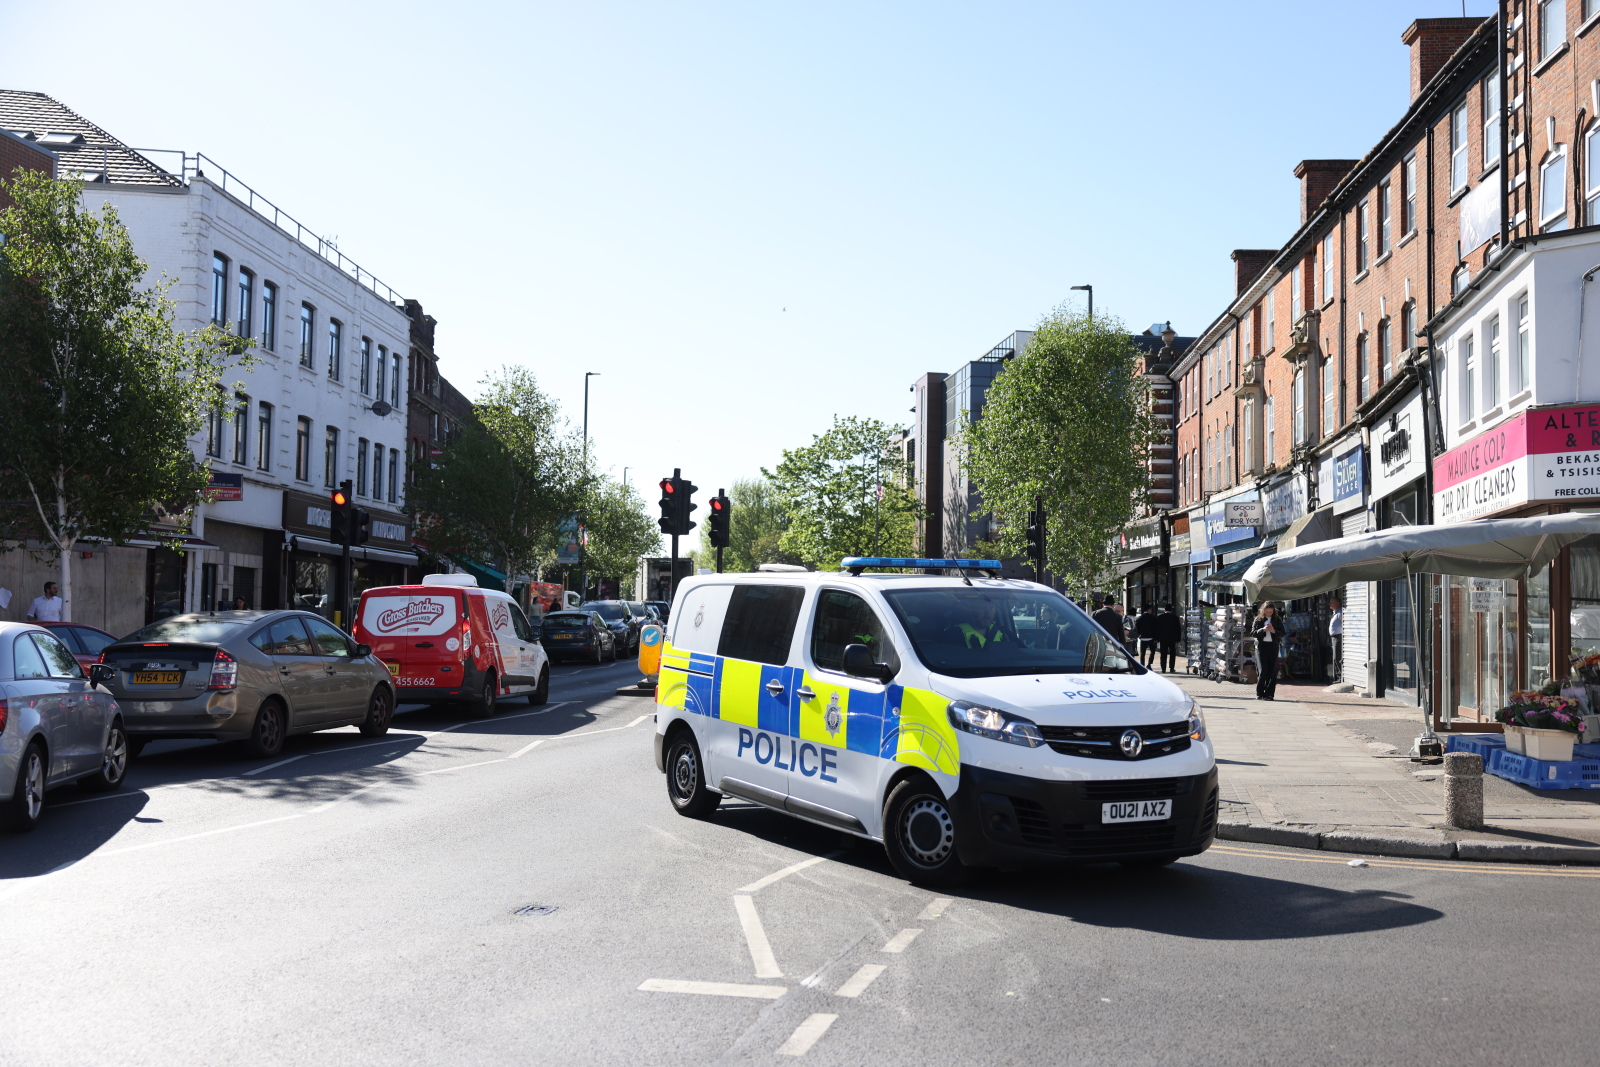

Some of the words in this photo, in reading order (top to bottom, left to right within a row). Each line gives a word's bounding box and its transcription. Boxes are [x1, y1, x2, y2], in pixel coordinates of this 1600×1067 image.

[1566, 433, 1577, 447] &
[1448, 444, 1479, 482] MAURICE
[1484, 432, 1506, 465] COLP
[1336, 461, 1357, 487] SILVER
[1546, 469, 1554, 478] &
[1336, 481, 1358, 497] PLACE
[1442, 491, 1453, 517] 2HR
[1457, 483, 1470, 511] DRY
[1474, 466, 1516, 504] CLEANERS
[1555, 488, 1576, 496] FREE
[382, 607, 407, 625] Gross
[408, 599, 443, 615] Butchers
[135, 672, 159, 682] YH54
[161, 672, 180, 682] TCK
[396, 678, 412, 686] 455
[413, 677, 435, 685] 6662
[1062, 689, 1137, 699] POLICE
[737, 727, 838, 783] POLICE
[1110, 803, 1139, 819] OU21
[1141, 801, 1167, 818] AXZ
